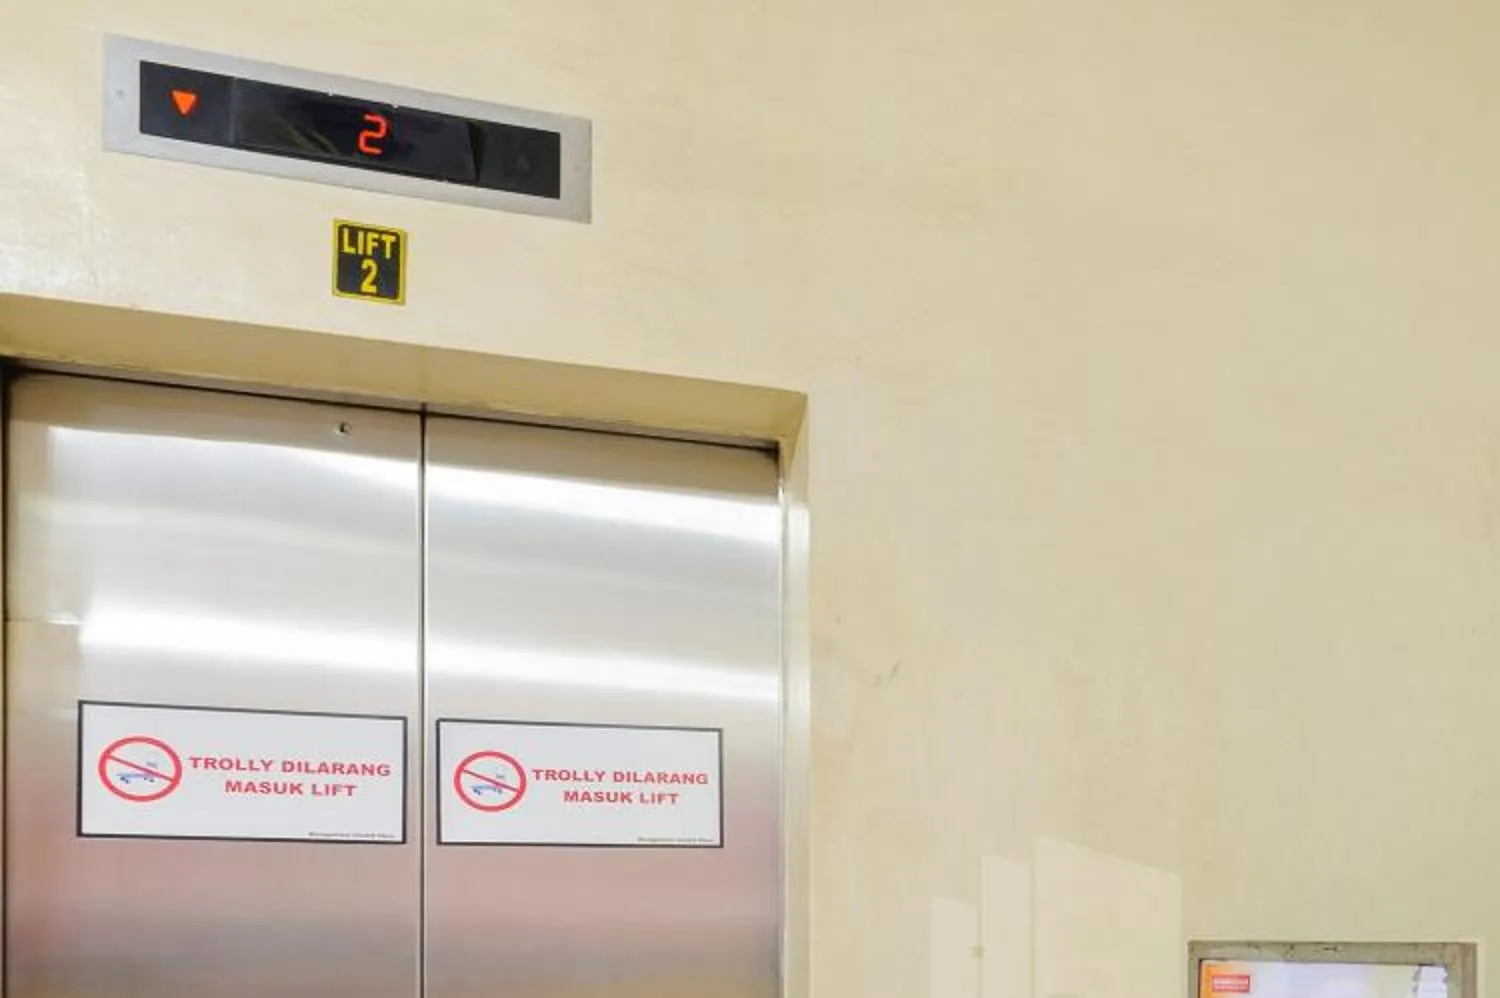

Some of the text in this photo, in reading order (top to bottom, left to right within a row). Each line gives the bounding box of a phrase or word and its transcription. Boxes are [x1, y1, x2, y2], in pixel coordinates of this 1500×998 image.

[358, 113, 388, 155] 2
[342, 227, 397, 259] LIFT
[360, 259, 378, 293] 2
[189, 757, 392, 777] TROLLY DILARANG
[532, 769, 709, 785] TROLLY DILARANG
[225, 780, 357, 797] MASUK LIFT
[563, 790, 680, 806] MASUK LIFT
